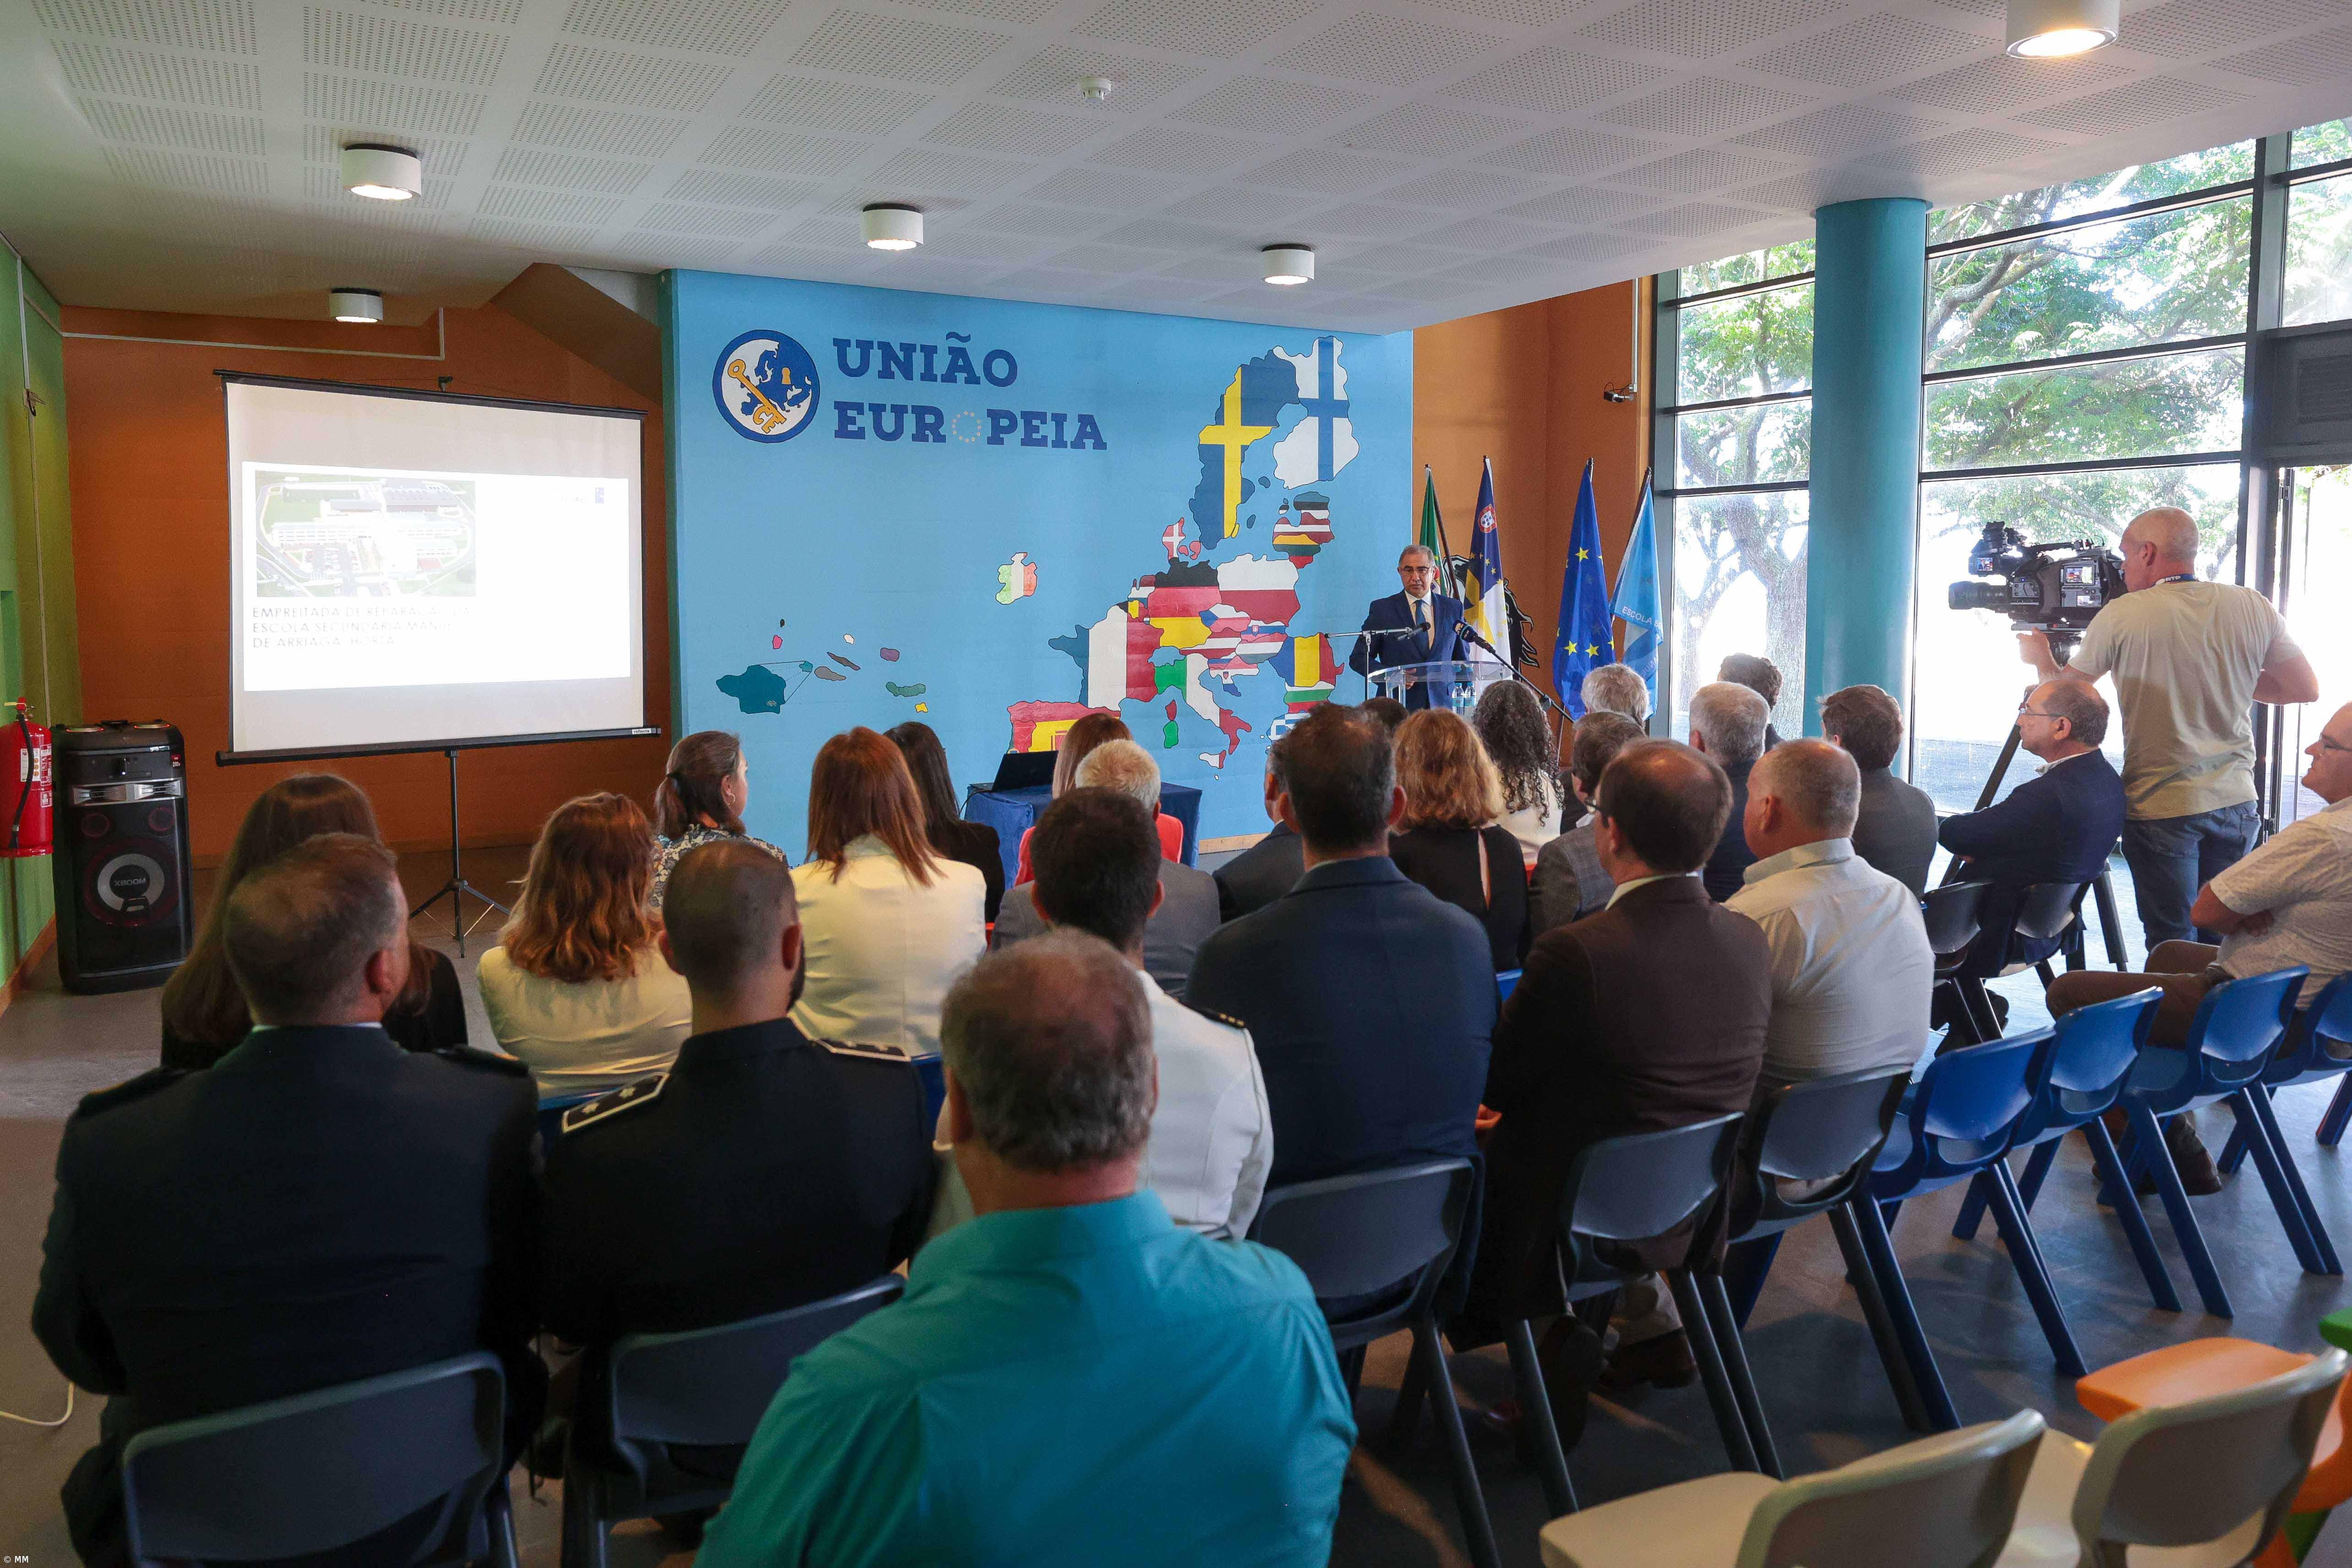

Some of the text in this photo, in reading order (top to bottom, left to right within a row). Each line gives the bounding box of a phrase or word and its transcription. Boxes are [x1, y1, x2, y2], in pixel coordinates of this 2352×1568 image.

[832, 331, 1018, 388] UNIÃO
[253, 607, 340, 617] EMPREITADA
[346, 607, 360, 617] DE
[1622, 606, 1652, 625] ESCOLA
[253, 623, 309, 633] ESCOLA
[253, 638, 271, 648] DE
[277, 637, 341, 647] ARRIAGA
[114, 877, 146, 887] XBOOM
